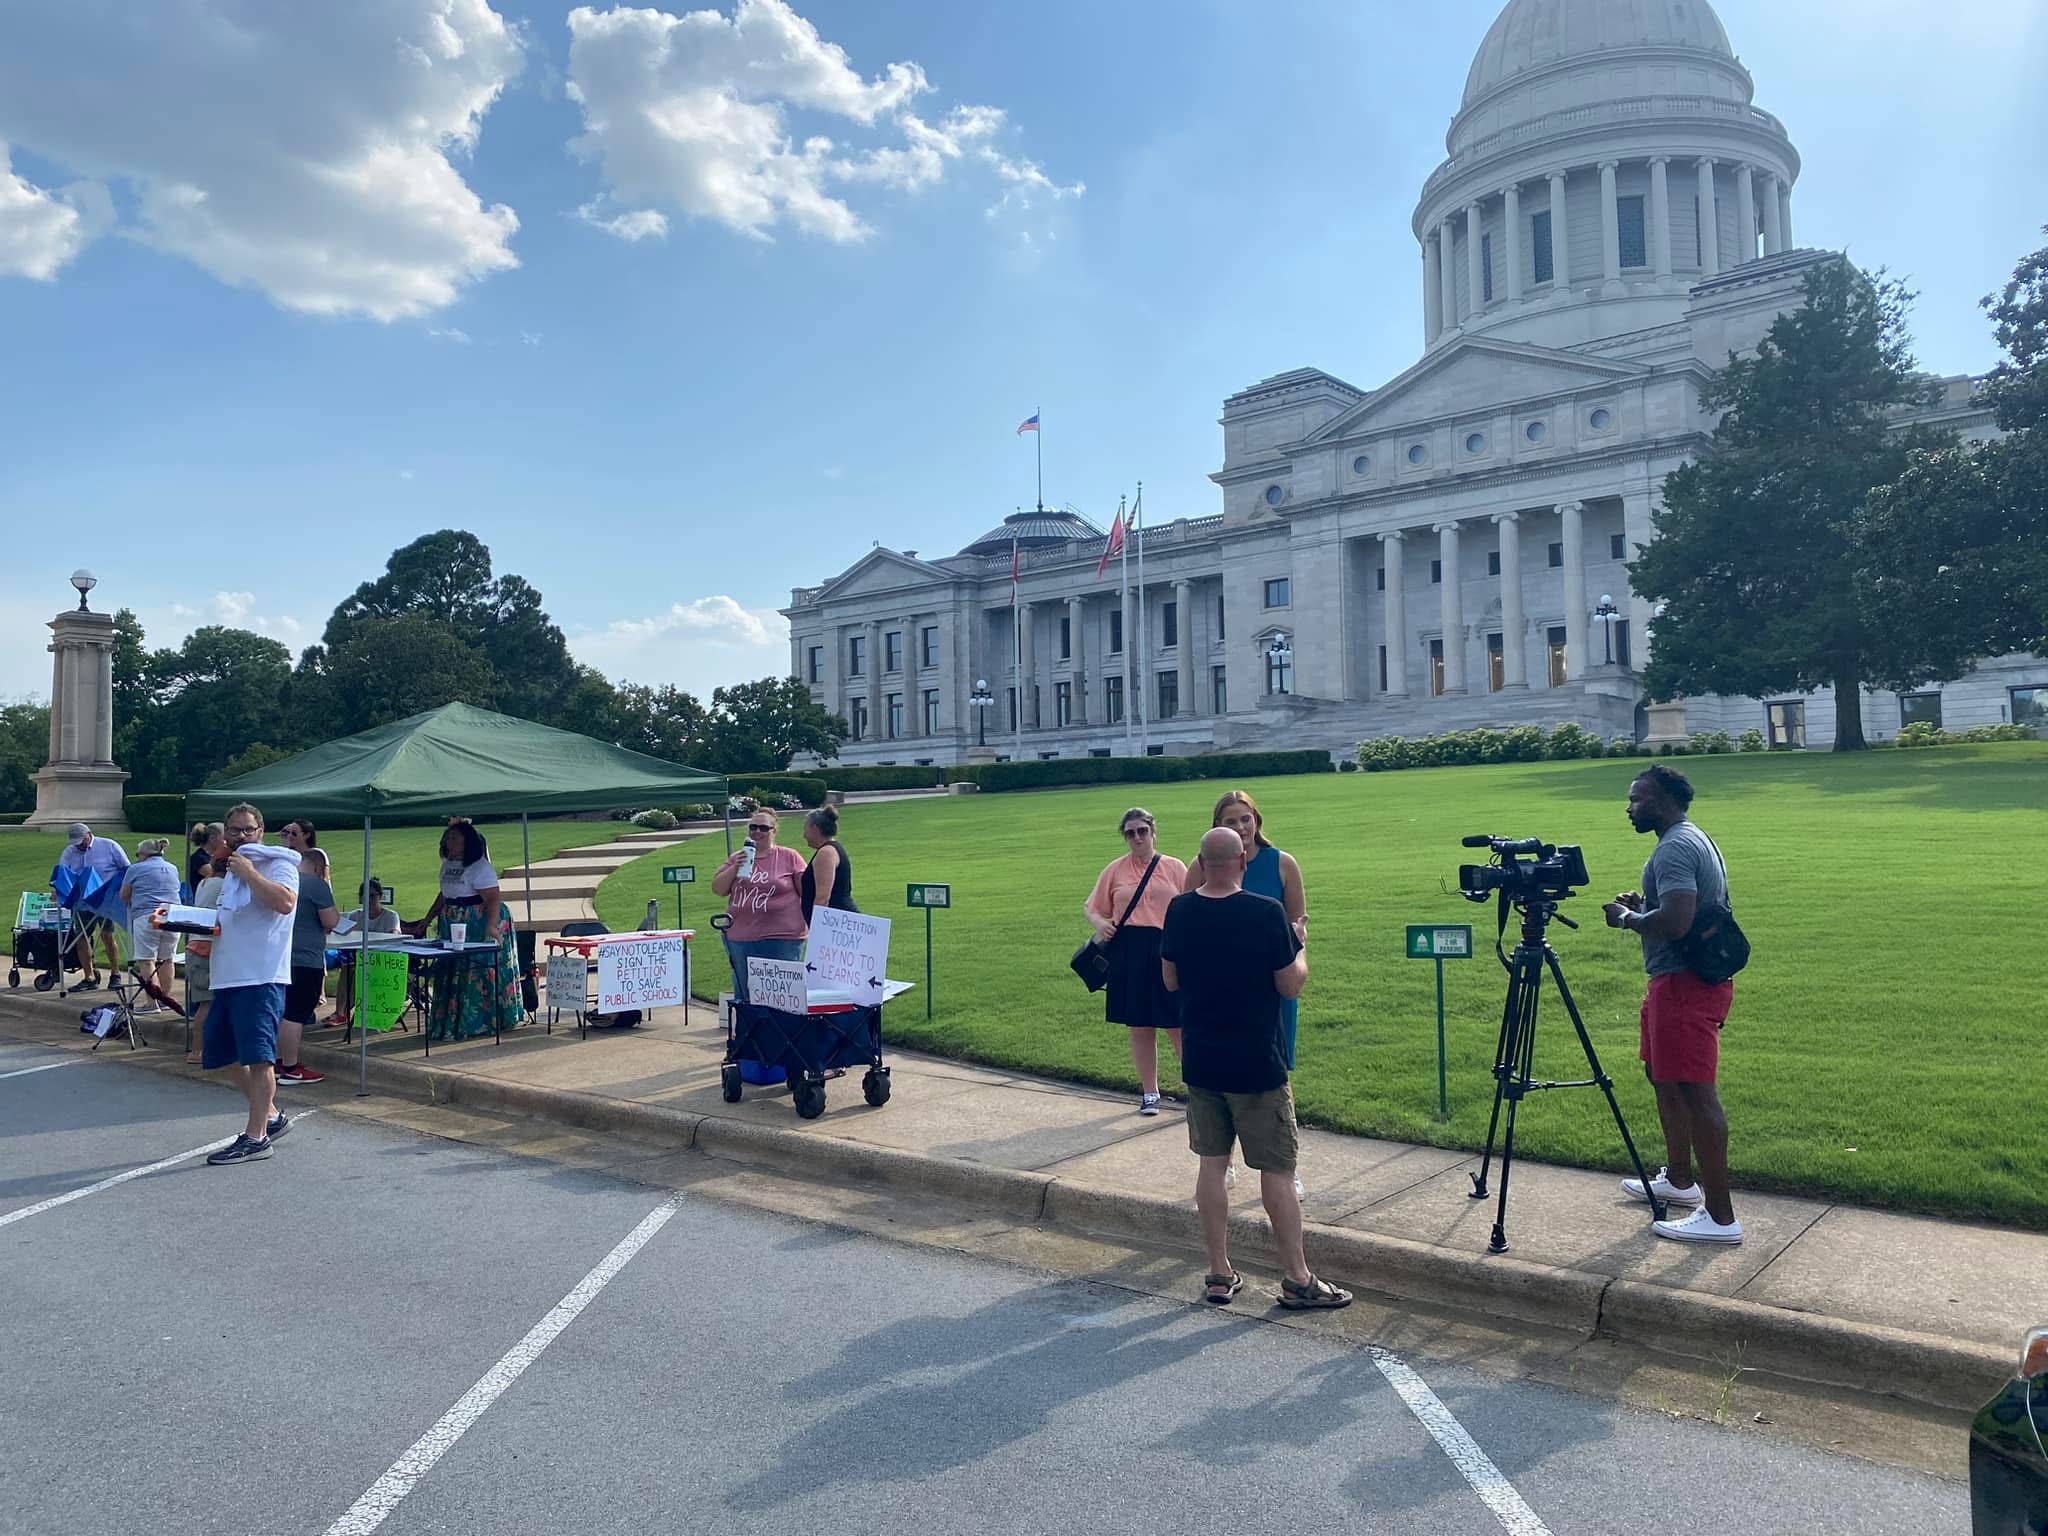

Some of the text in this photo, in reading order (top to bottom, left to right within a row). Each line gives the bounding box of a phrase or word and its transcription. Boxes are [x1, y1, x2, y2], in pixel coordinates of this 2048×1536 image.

[750, 867, 769, 883] be
[839, 914, 877, 935] PETITION
[598, 940, 682, 958] #SAYNOTOLEARNS
[831, 929, 862, 951] TODAY
[616, 953, 667, 969] SIGN THE
[818, 945, 876, 972] SAY NO TO
[617, 965, 667, 981] PETITION
[774, 964, 803, 981] PETITION
[821, 962, 861, 987] LEARNS
[621, 976, 662, 992] TO SAVE
[760, 977, 792, 994] TODAY
[604, 986, 678, 1007] PUBLIC SCHOOLS
[753, 989, 800, 1009] SAY NO TO
